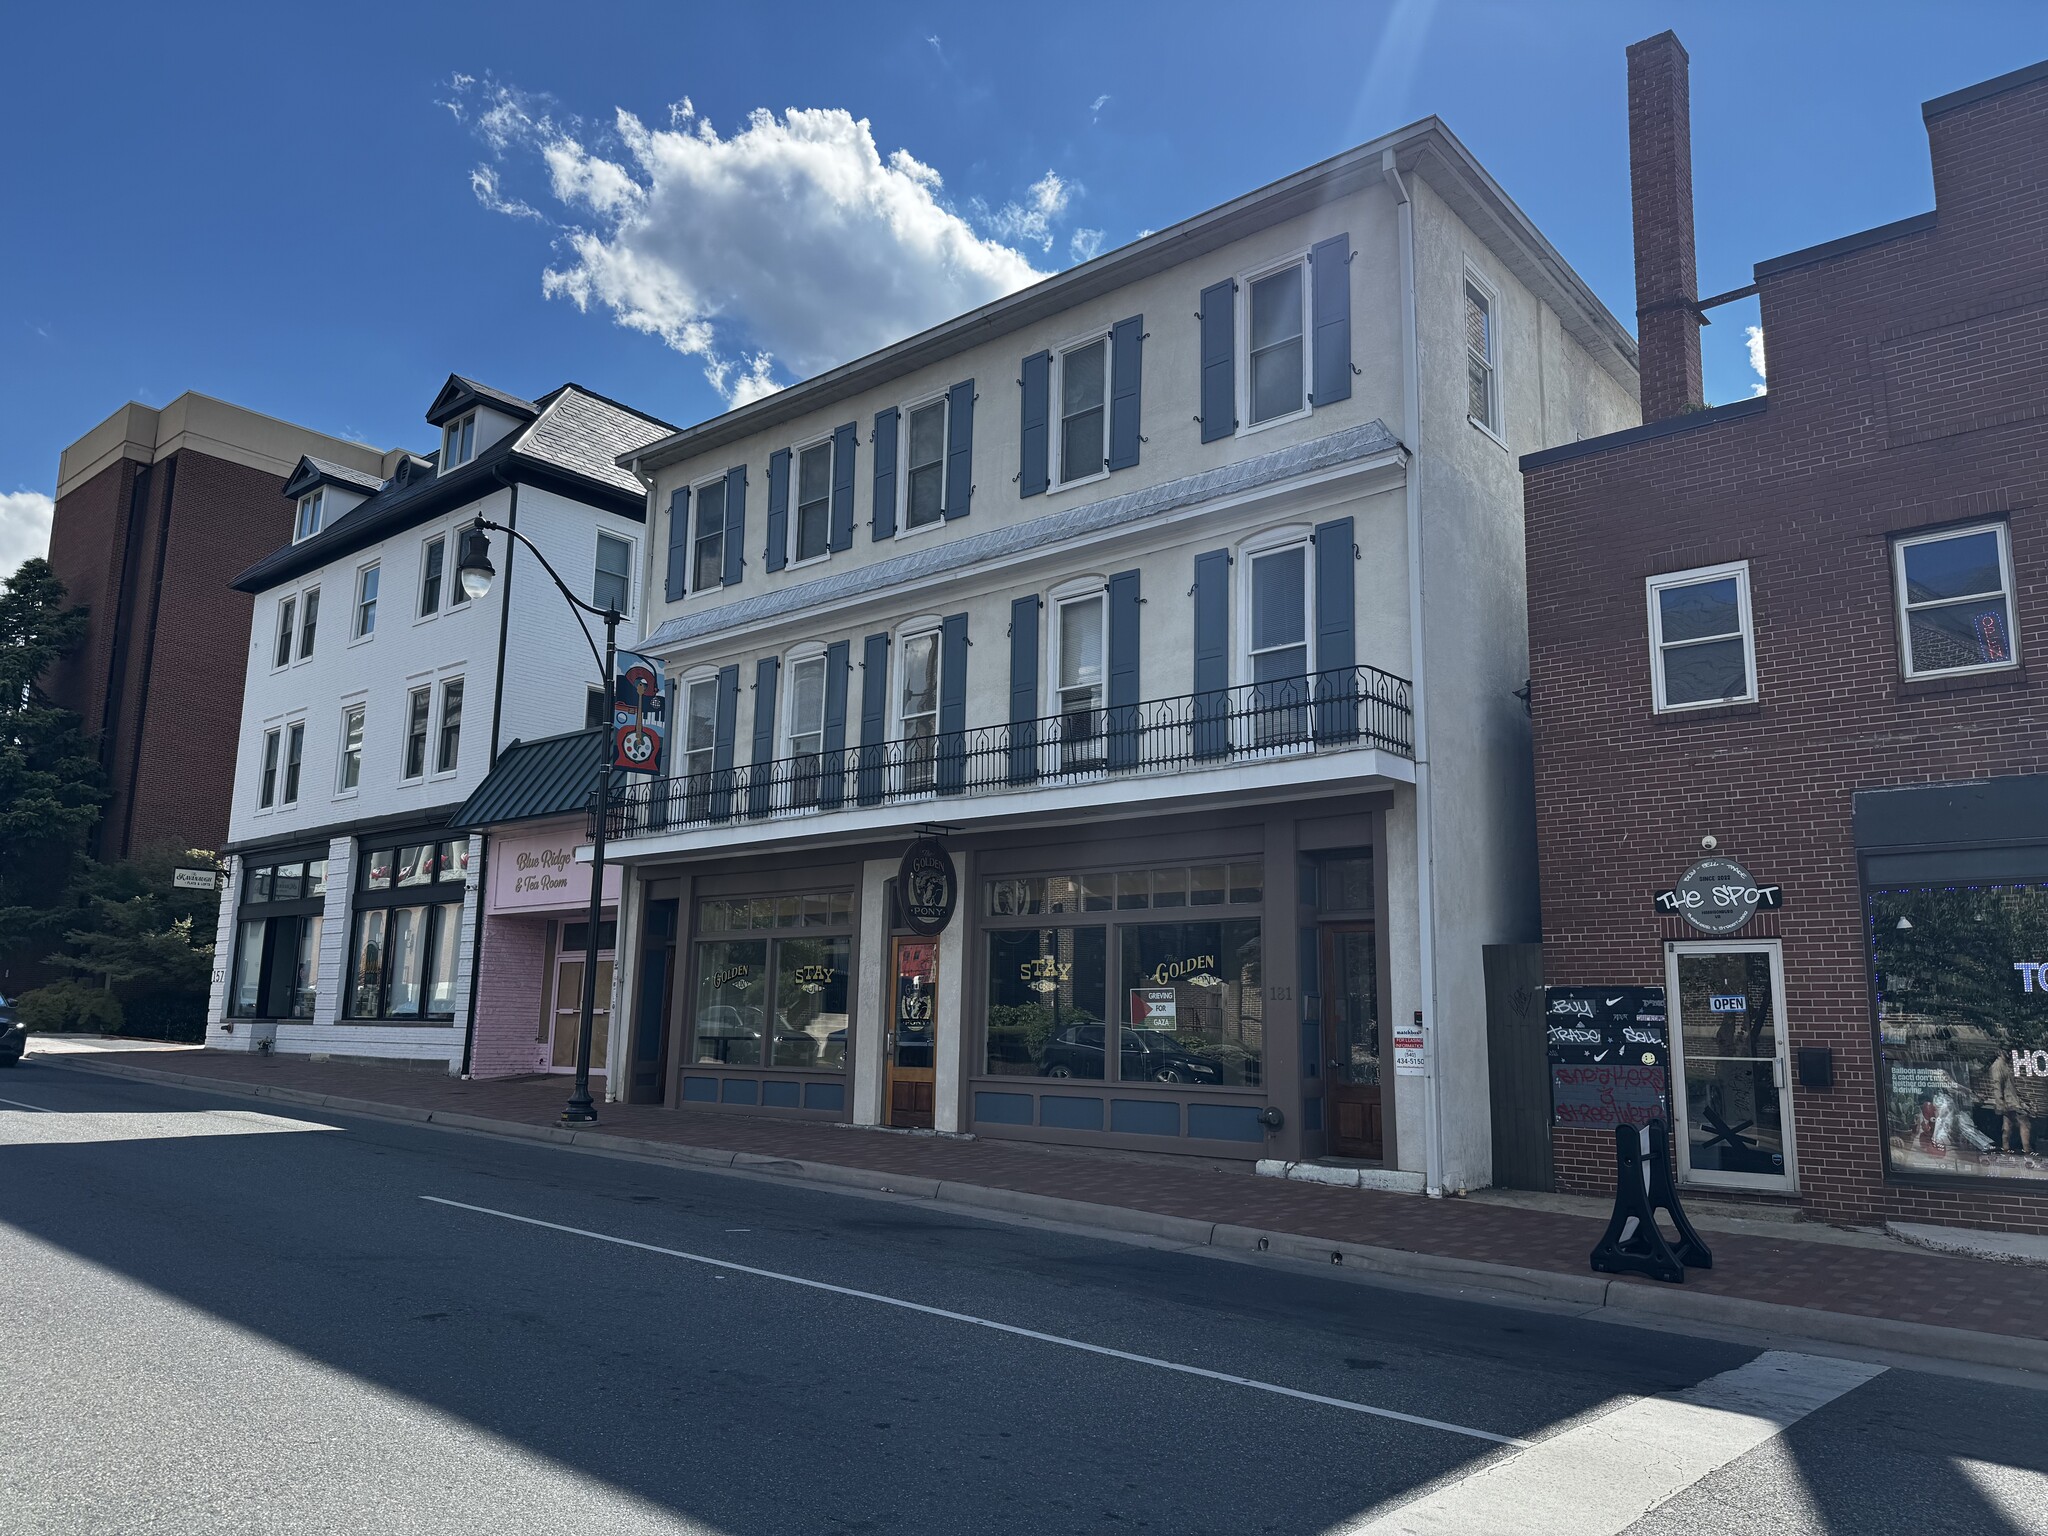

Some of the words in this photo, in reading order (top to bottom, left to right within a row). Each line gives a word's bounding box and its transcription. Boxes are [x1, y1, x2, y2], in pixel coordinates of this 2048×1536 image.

[516, 852, 540, 871] Blue
[541, 848, 571, 872] Ridge
[913, 857, 945, 872] GOLDEN
[515, 877, 523, 893] &
[524, 875, 539, 892] Tea
[540, 874, 568, 891] Room
[1712, 884, 1779, 907] SPOT
[914, 907, 943, 916] PONY
[795, 965, 835, 984] STAY
[1020, 959, 1072, 980] STAY
[1155, 955, 1214, 985] GOLDEN
[213, 971, 224, 982] 157
[713, 964, 749, 989] GOLDEN
[1148, 992, 1173, 1000] GRIEVING
[1270, 986, 1292, 1001] 181
[1155, 1004, 1167, 1012] FOR
[1713, 997, 1744, 1010] OPEN
[1153, 1018, 1170, 1026] GAZA
[1891, 1067, 1916, 1075] Balloon
[1892, 1080, 1917, 1088] Neither
[1918, 1080, 1926, 1088] do
[1927, 1081, 1958, 1089] cannabis
[1916, 1074, 1933, 1082] don't
[1899, 1087, 1923, 1095] driving.
